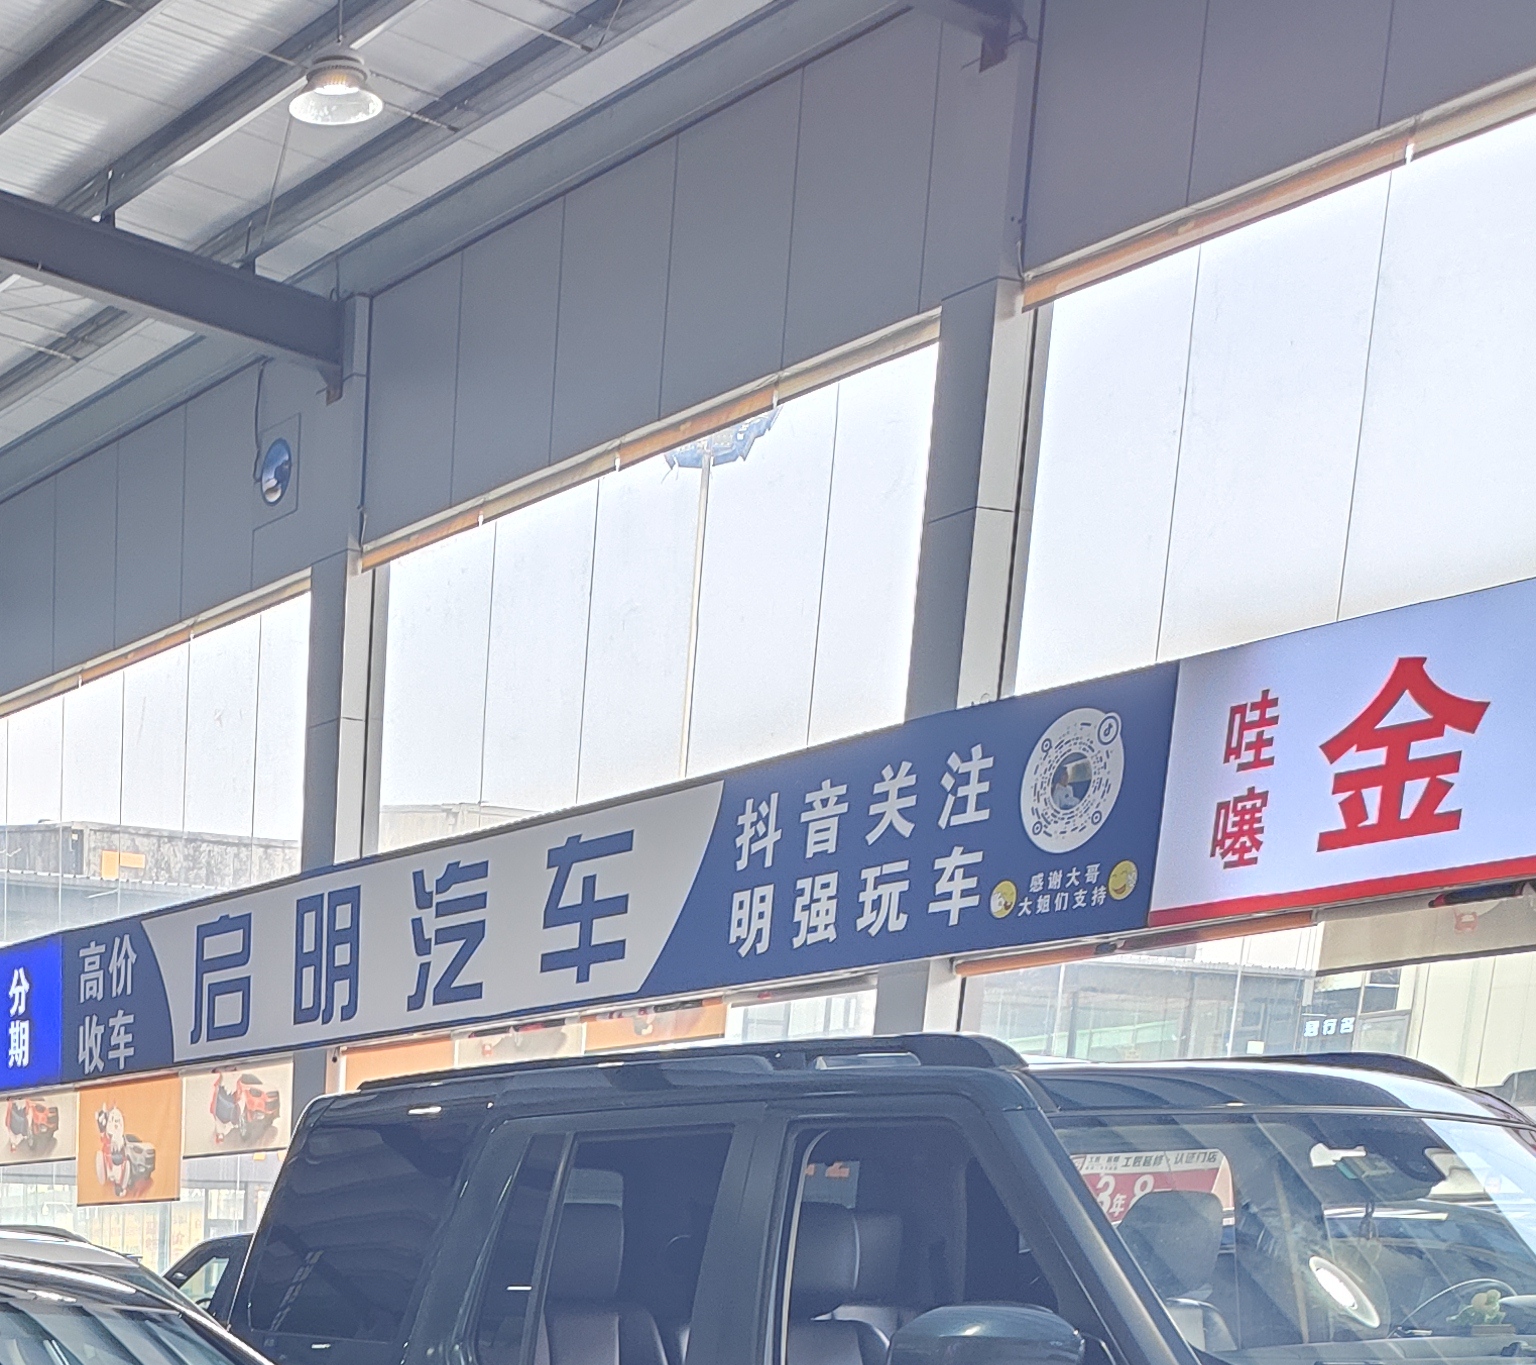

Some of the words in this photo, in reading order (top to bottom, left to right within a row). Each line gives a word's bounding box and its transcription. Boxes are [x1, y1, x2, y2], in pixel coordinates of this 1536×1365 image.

[1210, 688, 1280, 870] 哇噻
[1316, 655, 1490, 853] 金
[735, 743, 995, 872] 抖音关注
[729, 846, 984, 957] 明强玩车
[1017, 885, 1109, 917] 大姐们支持
[1029, 863, 1101, 893] 感谢大哥
[78, 934, 137, 1003] 高价
[191, 829, 634, 1045] 启明汽车
[8, 969, 30, 1069] 分期
[78, 1009, 136, 1074] 收车
